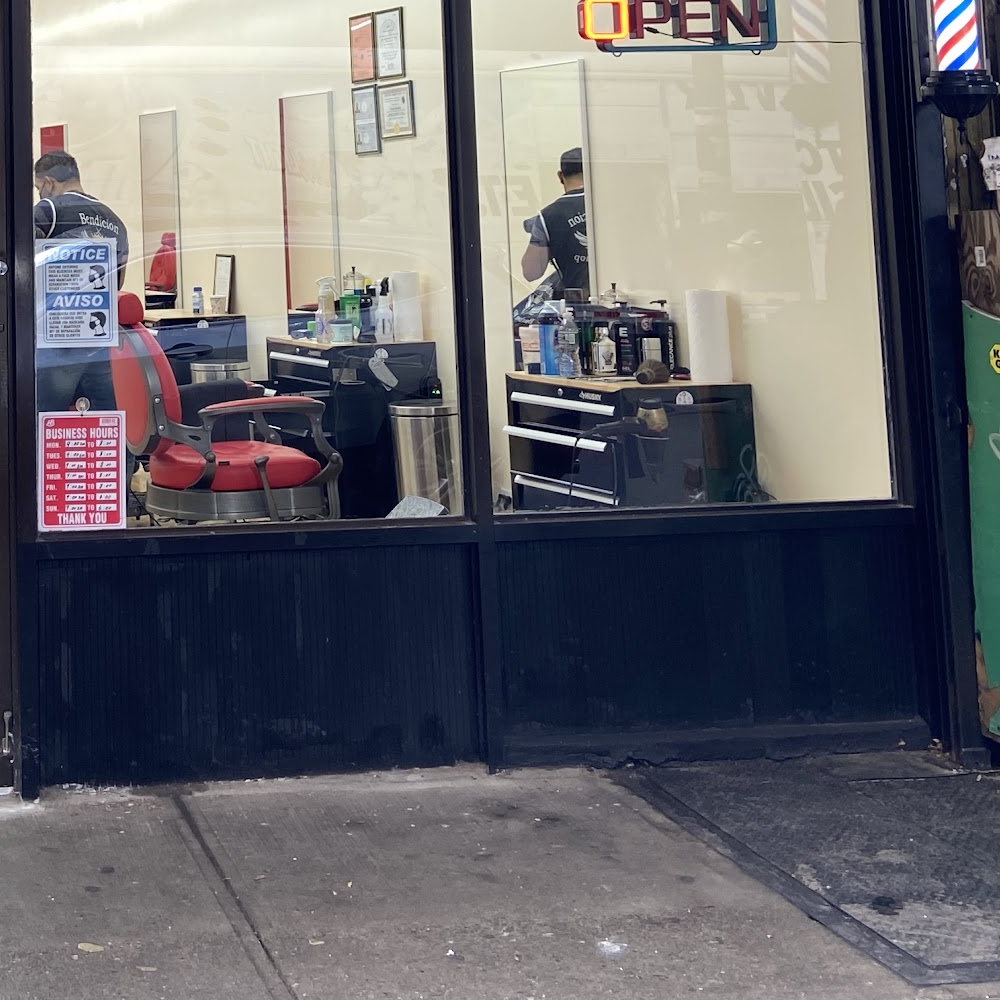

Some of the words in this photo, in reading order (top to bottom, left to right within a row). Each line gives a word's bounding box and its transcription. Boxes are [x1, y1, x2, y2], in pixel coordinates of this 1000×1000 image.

[52, 295, 103, 308] AVISO
[46, 428, 87, 439] BUSINESS
[90, 427, 119, 438] HOURS
[57, 513, 86, 524] THANK
[89, 512, 107, 523] YOU
